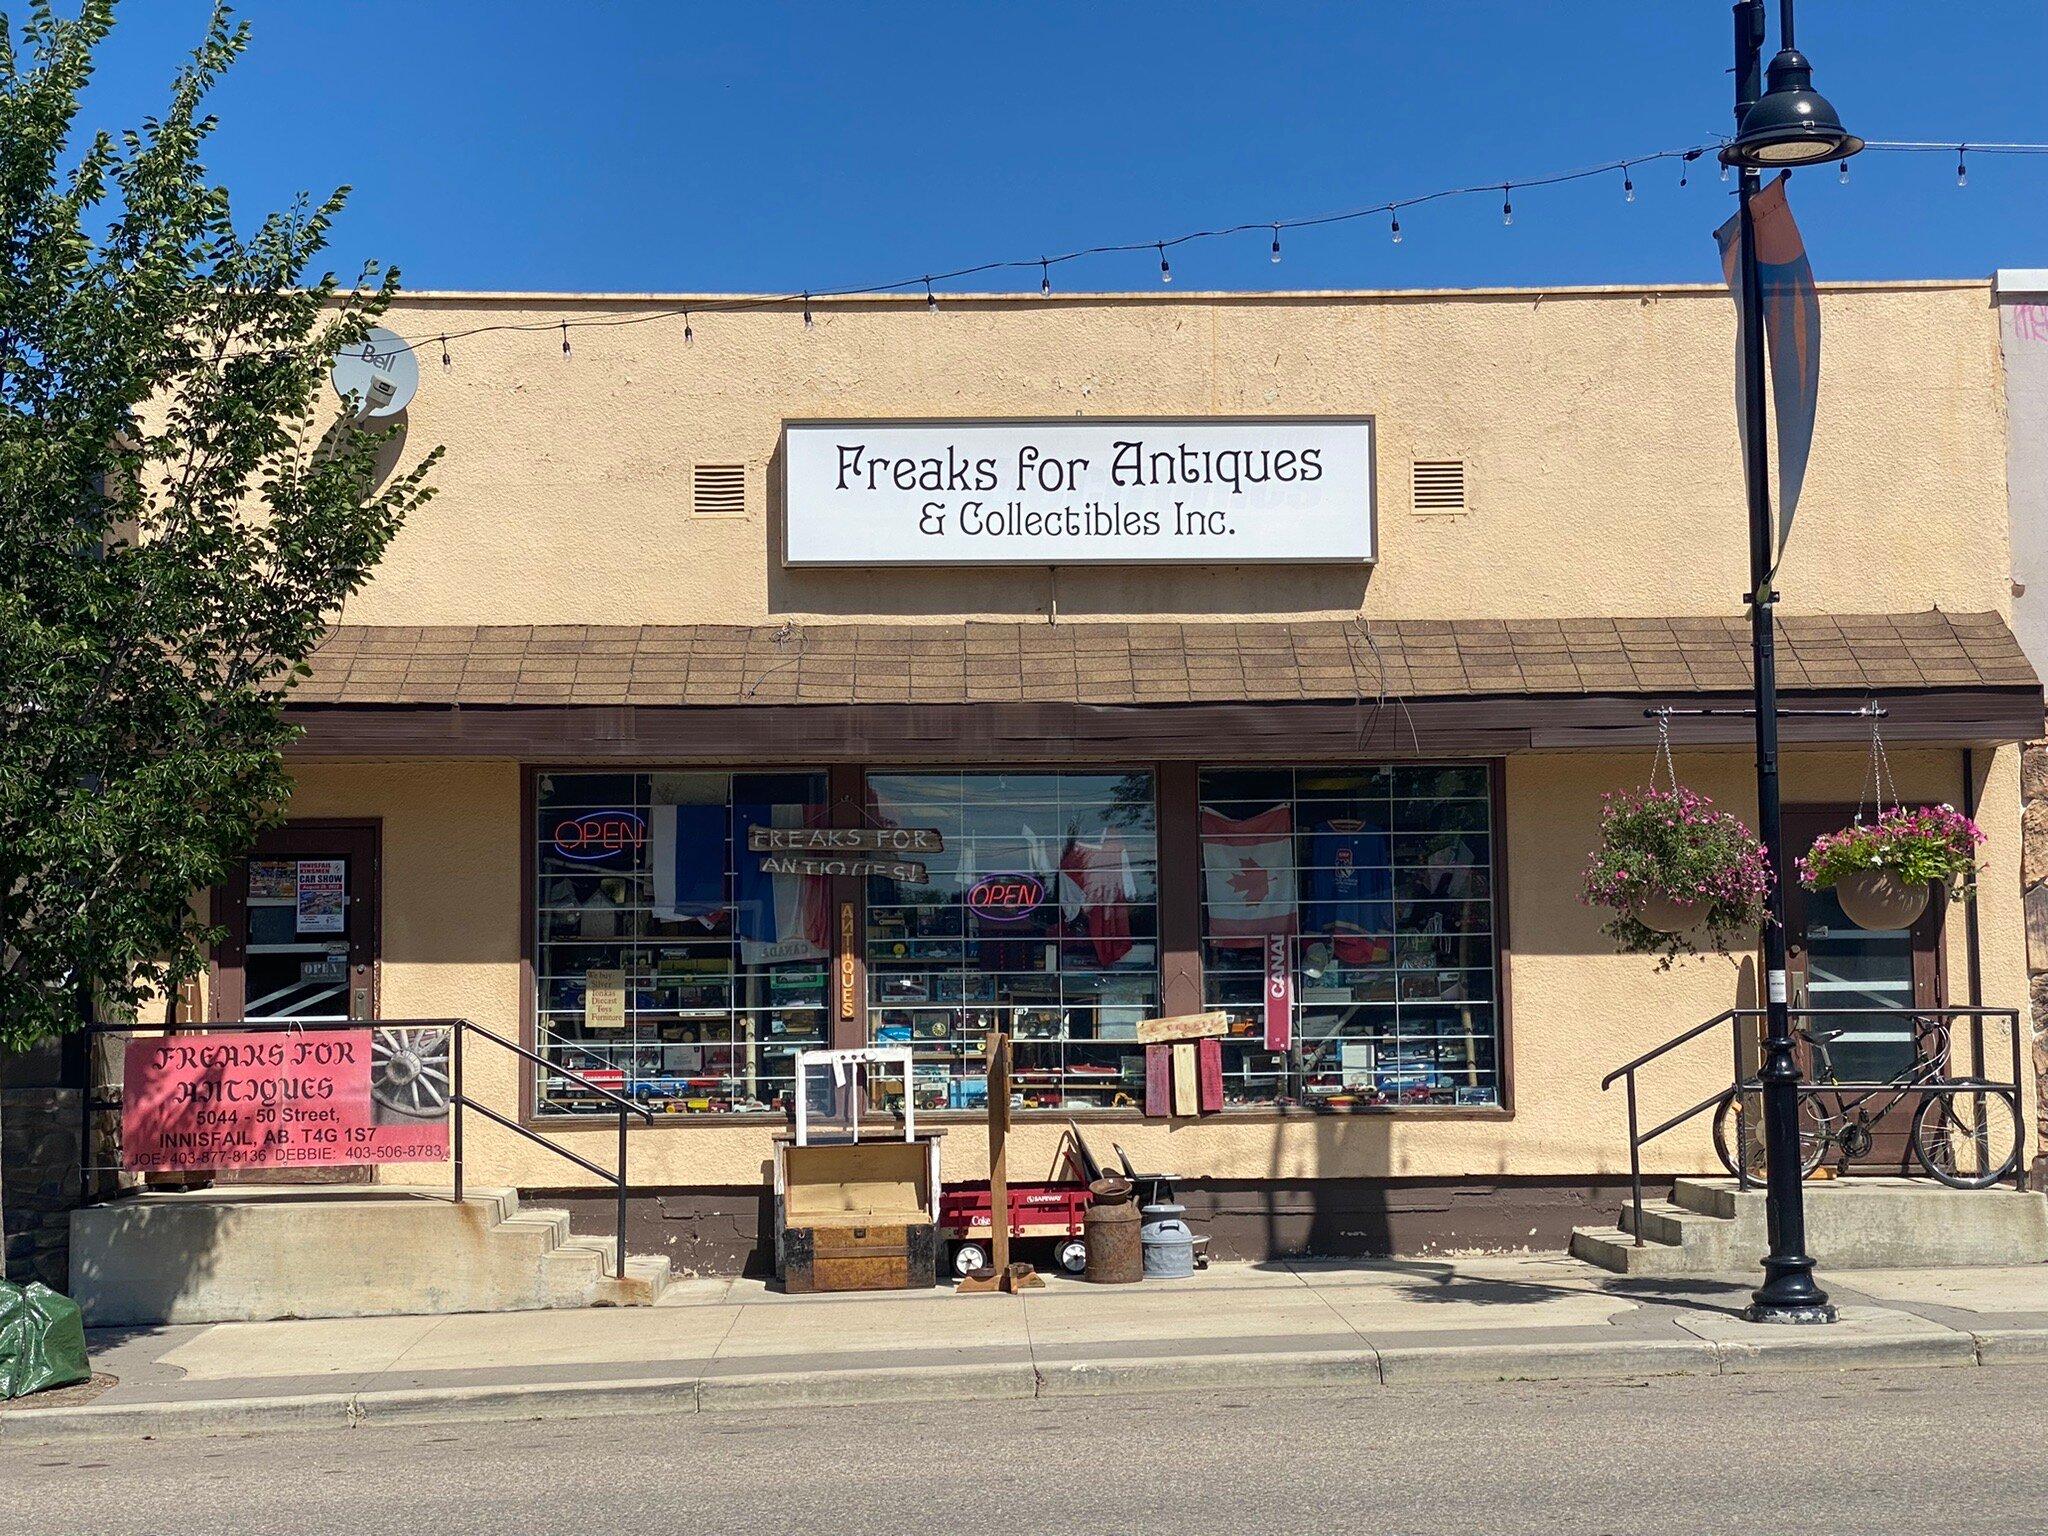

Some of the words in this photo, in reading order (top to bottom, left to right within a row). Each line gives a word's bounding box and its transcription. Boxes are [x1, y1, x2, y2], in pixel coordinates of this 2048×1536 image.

[361, 344, 396, 373] Bell
[835, 445, 998, 492] Freaks
[1017, 446, 1090, 492] for
[1112, 441, 1324, 494] Antiques
[918, 502, 945, 536] &
[960, 501, 1161, 536] Collectibles
[1174, 501, 1236, 536] Inc.
[555, 821, 643, 849] OPEN
[754, 829, 861, 848] FREAKS
[877, 830, 927, 849] FOR
[300, 875, 316, 883] CAR
[317, 875, 343, 883] SHOW
[971, 884, 1038, 907] OPEN
[842, 904, 855, 1018] ANTIQUES
[592, 989, 616, 997] Tonkas
[591, 1013, 623, 1021] Furniture
[596, 1005, 612, 1014] Toys
[153, 1043, 284, 1070] FREAKS
[291, 1042, 355, 1065] FOR
[173, 1077, 334, 1107] ANTIQUES
[196, 1109, 238, 1125] 5044
[256, 1108, 276, 1123] 50
[282, 1107, 340, 1123] Street,
[160, 1131, 257, 1148] INNISFAIL,
[263, 1129, 295, 1145] AB.
[301, 1128, 338, 1143] T4G
[345, 1127, 377, 1142] 1S7
[131, 1153, 166, 1166] JOE:
[170, 1150, 267, 1165] 403-877-8136
[275, 1148, 336, 1161] DEBBIE:
[345, 1144, 442, 1159] 403-506-8783
[971, 1215, 992, 1226] Coke
